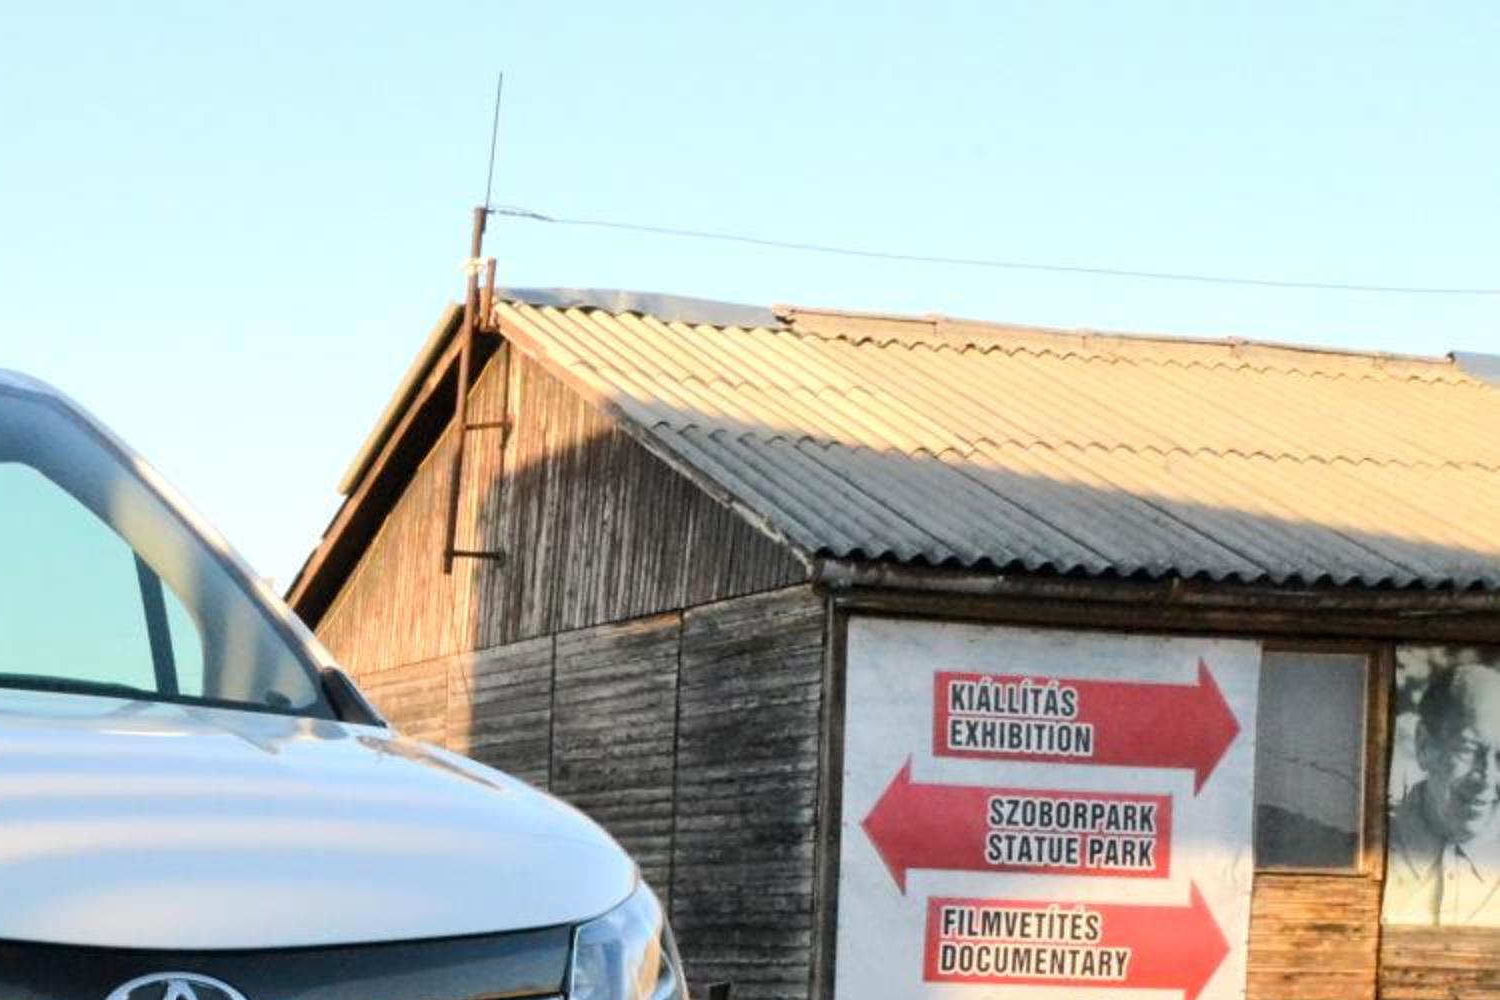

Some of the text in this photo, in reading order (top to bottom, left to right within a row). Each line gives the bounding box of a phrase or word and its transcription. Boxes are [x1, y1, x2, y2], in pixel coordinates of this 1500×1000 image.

[951, 681, 1076, 717] KIÁLLÍTÁS
[950, 720, 1092, 753] EXHIBITION
[990, 799, 1154, 832] SZOBORPARK
[988, 835, 1153, 866] STATUE PARK
[944, 906, 1099, 940] FILMVETÍTÉS
[941, 946, 1128, 977] DOCUMENTARY
